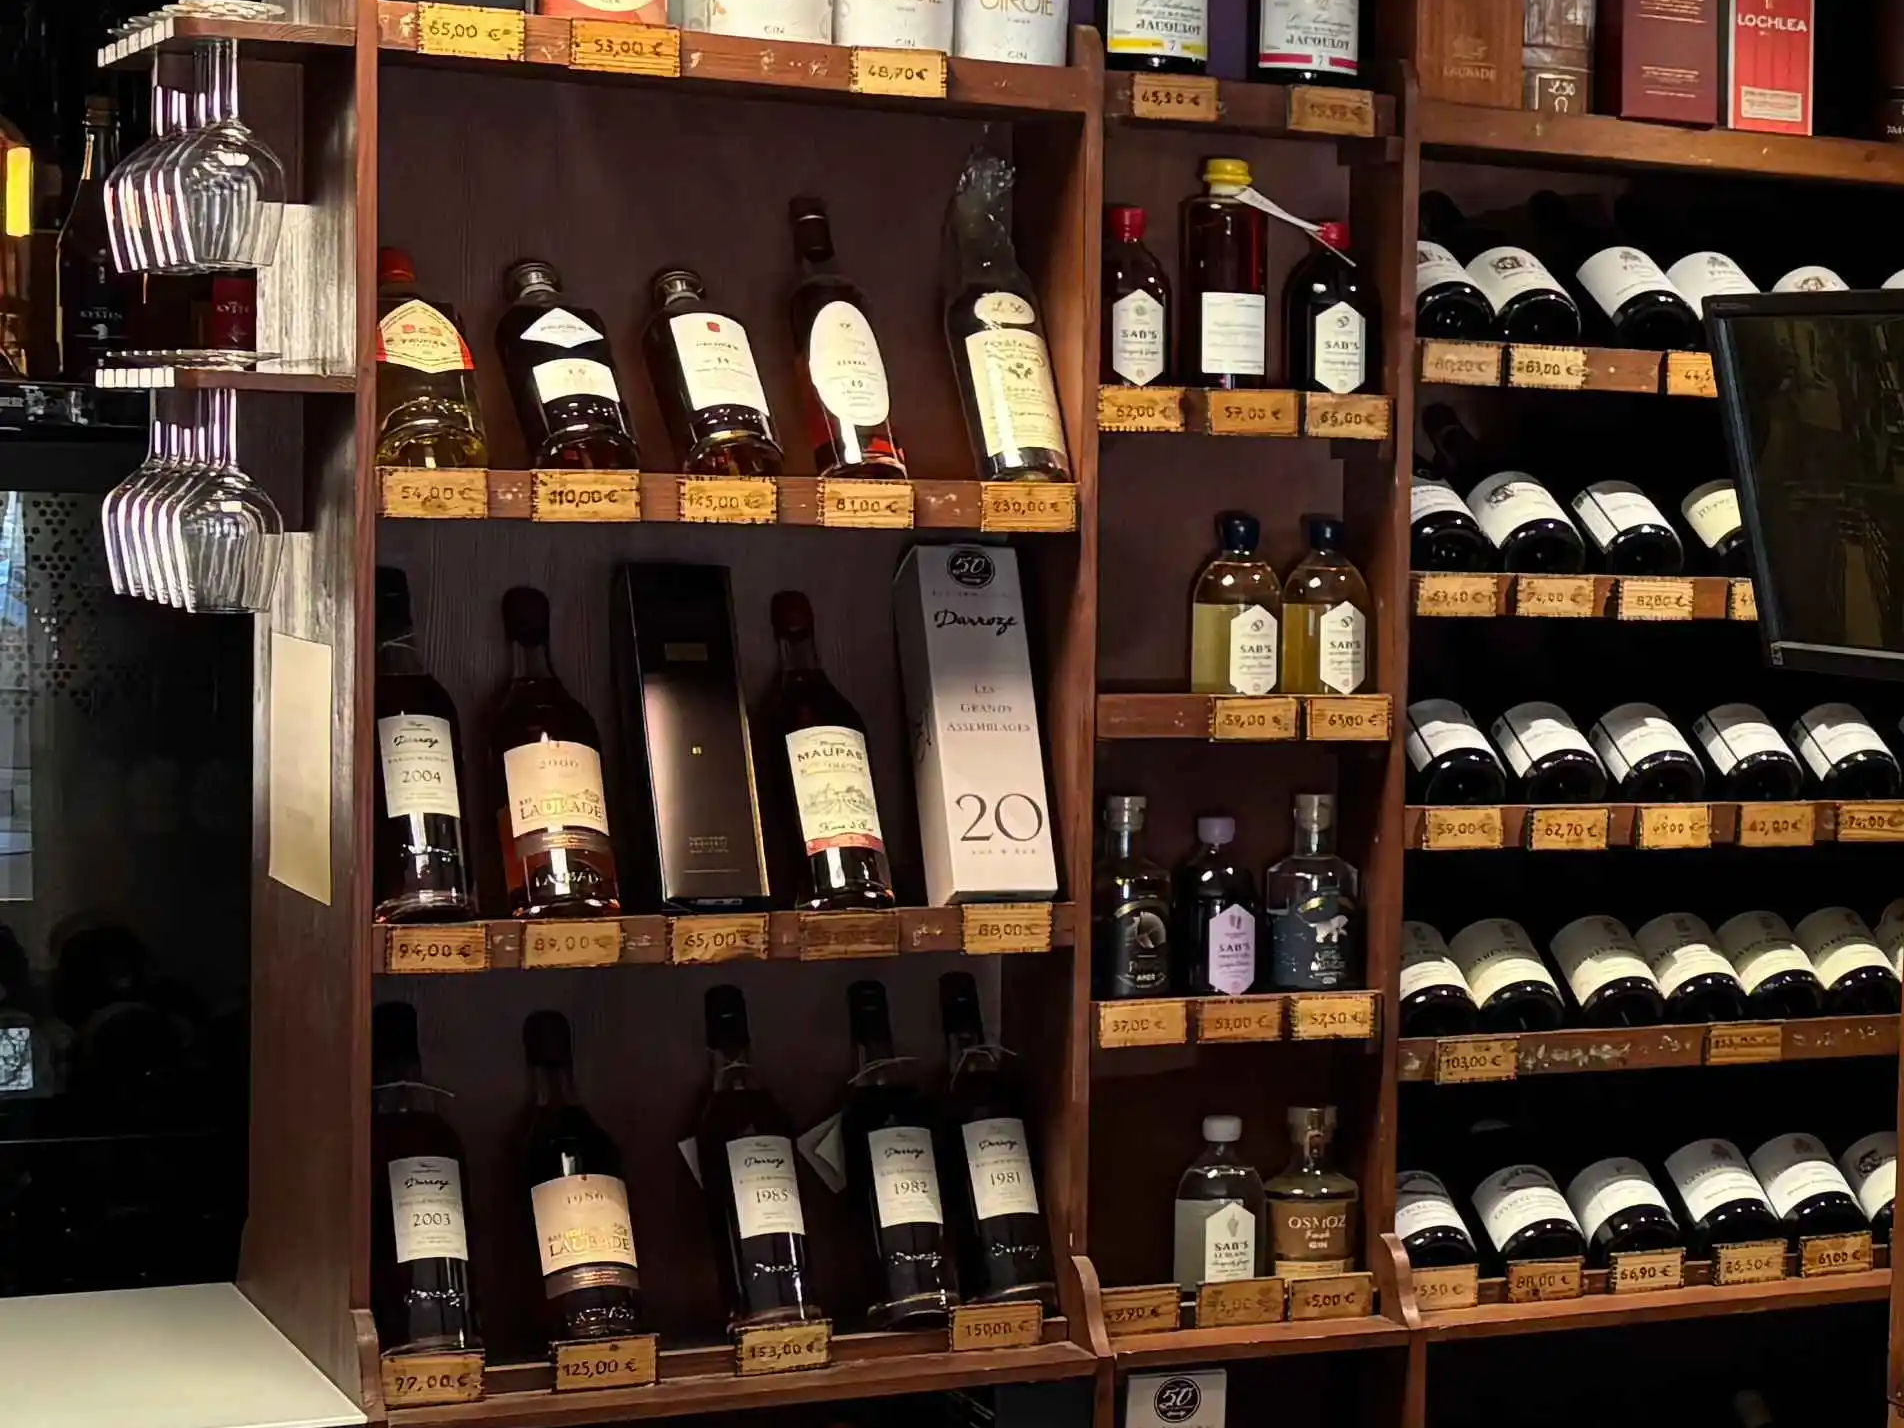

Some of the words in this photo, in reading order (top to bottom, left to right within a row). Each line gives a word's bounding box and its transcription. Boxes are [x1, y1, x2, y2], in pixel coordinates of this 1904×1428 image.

[1736, 12, 1808, 32] LOCHLEA
[953, 556, 986, 574] 50
[934, 608, 1017, 635] Darroze
[946, 721, 1031, 734] ASSEMBLAGES
[401, 770, 441, 784] 2004
[955, 793, 1043, 842] 20
[892, 1179, 929, 1196] 1982
[989, 1172, 1022, 1187] 1981
[412, 1212, 451, 1227] 2003
[1288, 1214, 1346, 1230] OSMOZ
[1159, 1386, 1195, 1408] 50
